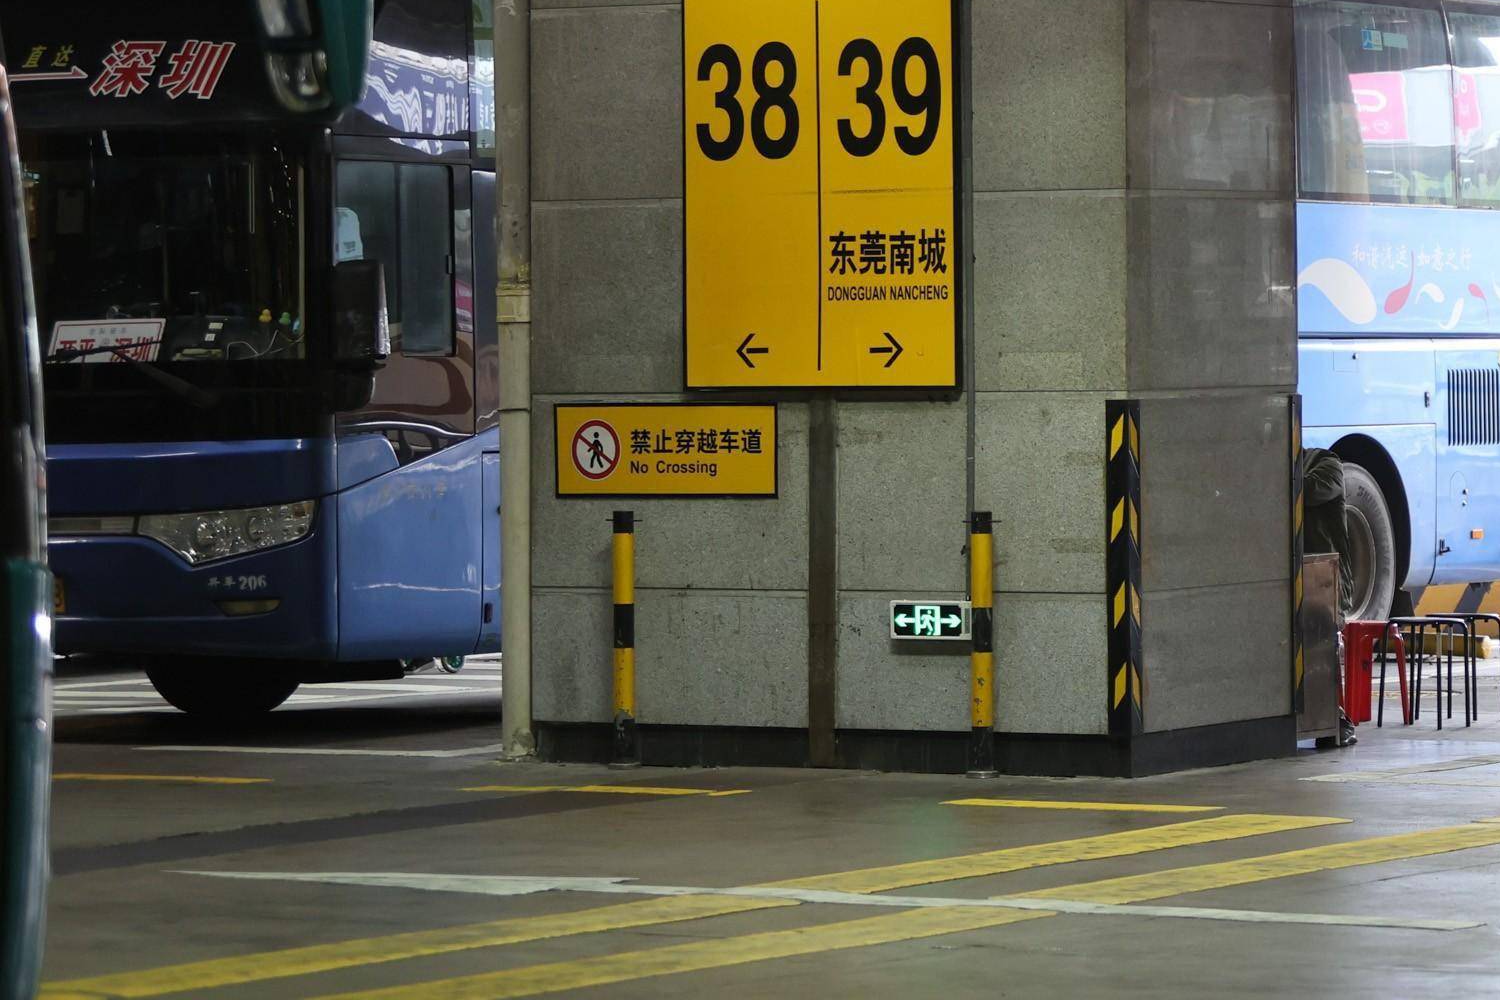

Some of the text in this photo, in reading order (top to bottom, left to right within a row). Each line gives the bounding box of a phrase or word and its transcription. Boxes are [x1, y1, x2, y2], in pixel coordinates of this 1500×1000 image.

[22, 45, 74, 68] 直达
[89, 40, 236, 99] 深圳
[696, 41, 800, 161] 38
[837, 37, 942, 157] 39
[829, 229, 947, 275] 东莞南城
[828, 285, 949, 300] DONGGUAN NANCHENG
[630, 428, 762, 454] 禁止穿越车道
[630, 460, 718, 477] No Crossing
